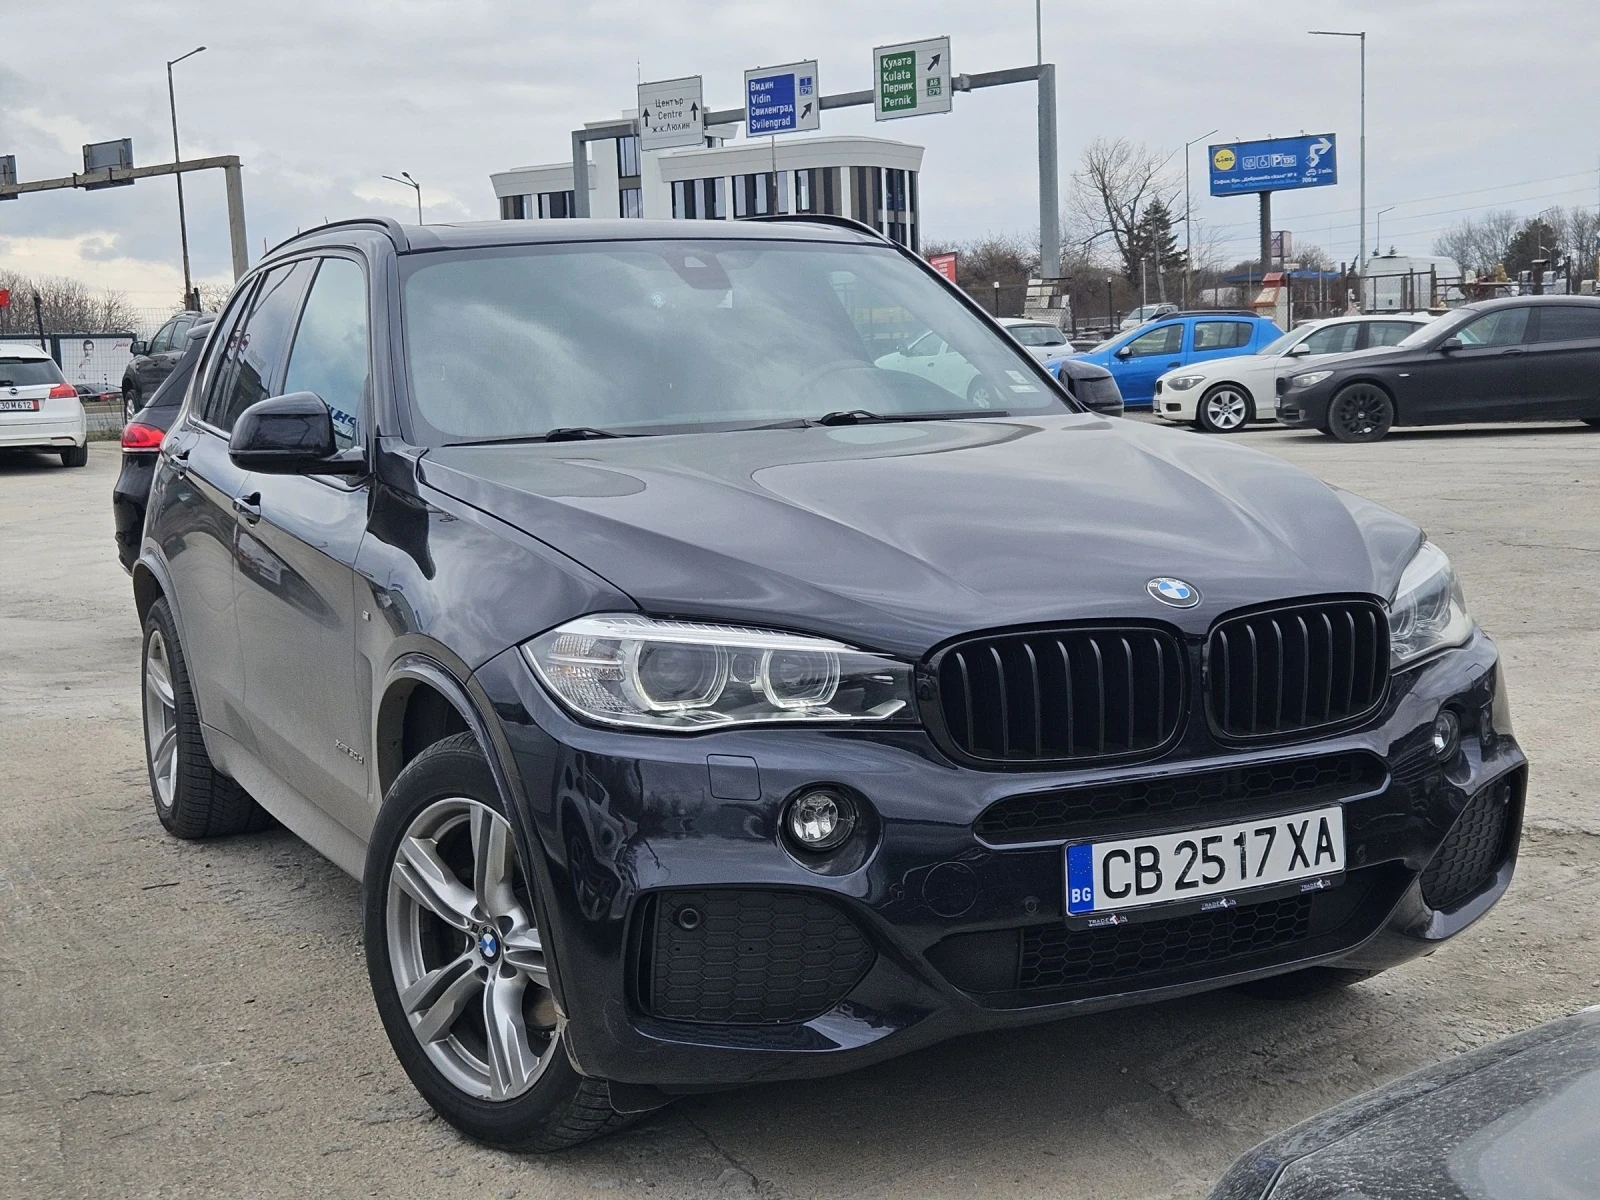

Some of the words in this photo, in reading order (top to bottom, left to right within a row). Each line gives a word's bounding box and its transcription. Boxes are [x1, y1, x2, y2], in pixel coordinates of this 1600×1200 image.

[883, 57, 912, 70] Кулата
[883, 71, 911, 82] Kulata
[750, 81, 774, 92] Видин
[800, 86, 812, 95] E79
[883, 83, 914, 94] Перник
[655, 97, 684, 108] Център
[751, 94, 771, 104] Vidin
[884, 96, 912, 107] Pernik
[657, 110, 683, 120] Centre
[751, 104, 794, 117] Свиленград
[751, 117, 791, 130] Svilengrad
[1102, 844, 1163, 900] CB
[1173, 825, 1278, 891] 2517
[1286, 816, 1337, 872] XA
[1071, 888, 1092, 903] BG
[1088, 917, 1111, 925] TRADE
